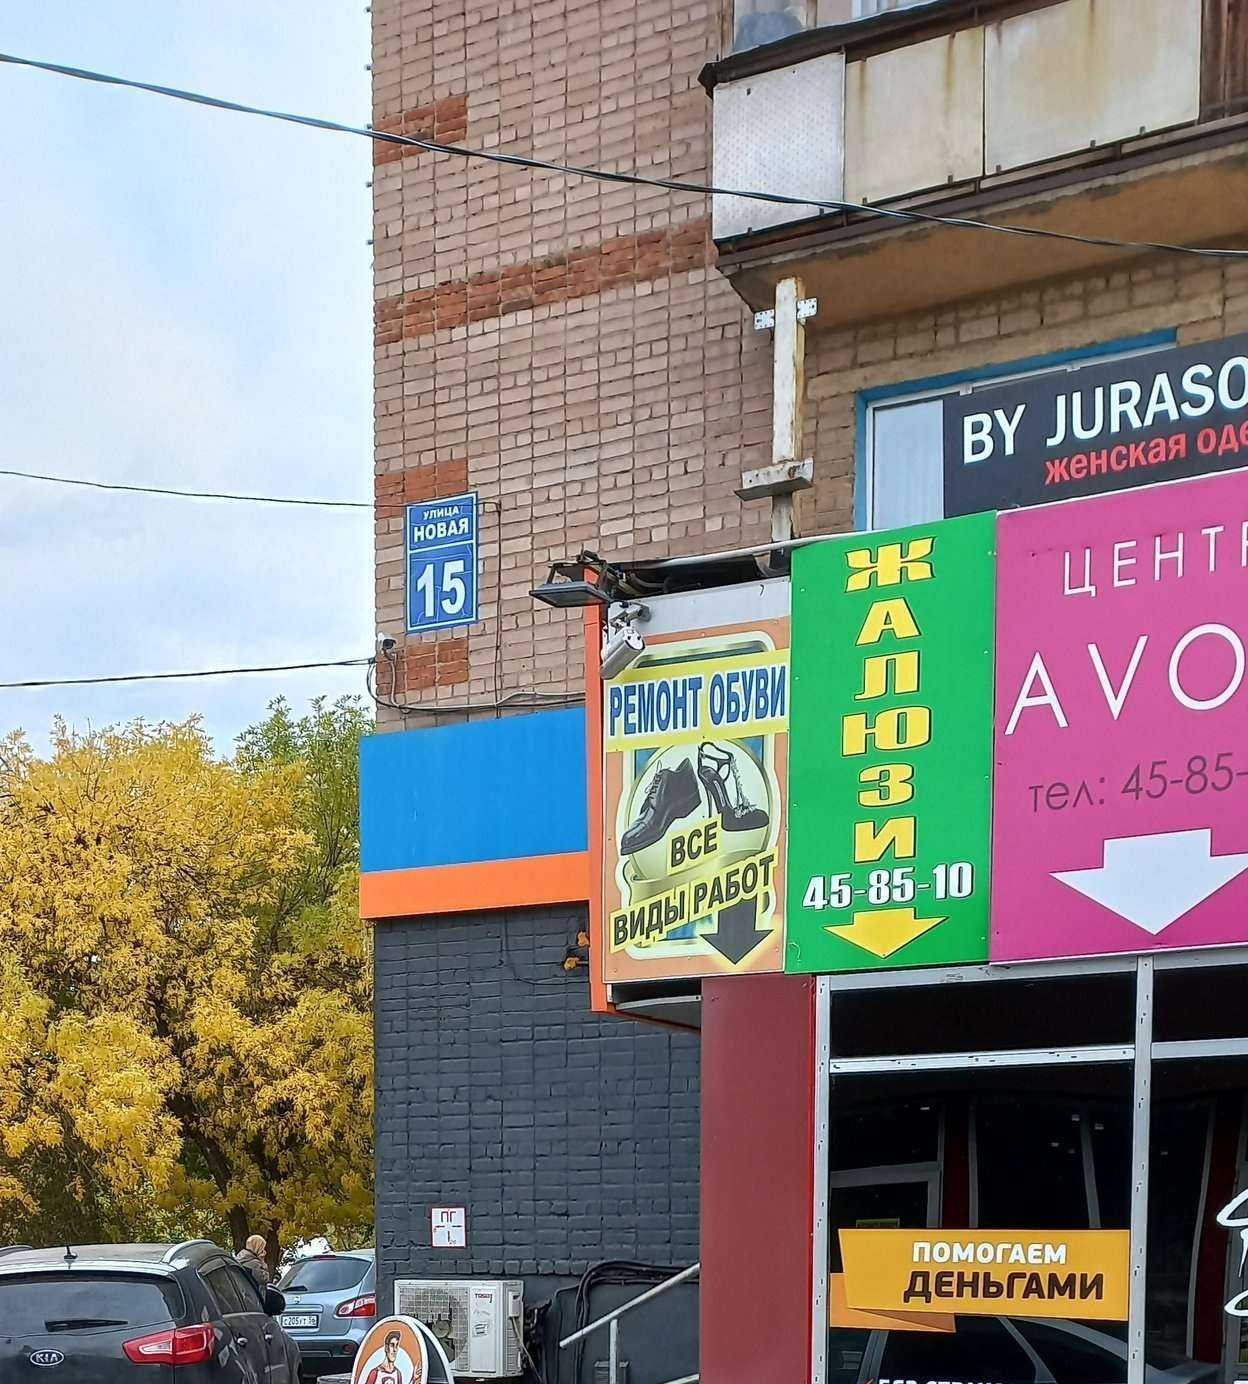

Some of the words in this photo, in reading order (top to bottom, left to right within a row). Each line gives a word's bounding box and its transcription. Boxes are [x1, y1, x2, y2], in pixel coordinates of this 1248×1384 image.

[961, 403, 1026, 465] BY
[1045, 356, 1248, 449] JURASO
[1044, 432, 1187, 486] женская
[413, 518, 469, 543] НОВАЯ
[423, 505, 460, 520] УЛИЦА
[416, 560, 466, 618] 15
[609, 676, 702, 737] РЕМОНТ
[709, 665, 787, 726] ОБУВИ
[842, 536, 937, 863] ЖАЛЮЗИ
[1004, 622, 1246, 735] AVO
[1028, 776, 1105, 812] тел:
[670, 821, 718, 868] ВСЕ
[613, 890, 685, 947] ВИДЫ
[693, 853, 775, 915] РАБОТ
[802, 861, 974, 911] 45-85-10
[912, 1241, 1067, 1265] ПОМОГАЕМ
[903, 1270, 1104, 1304] ДЕНЬГАМИ
